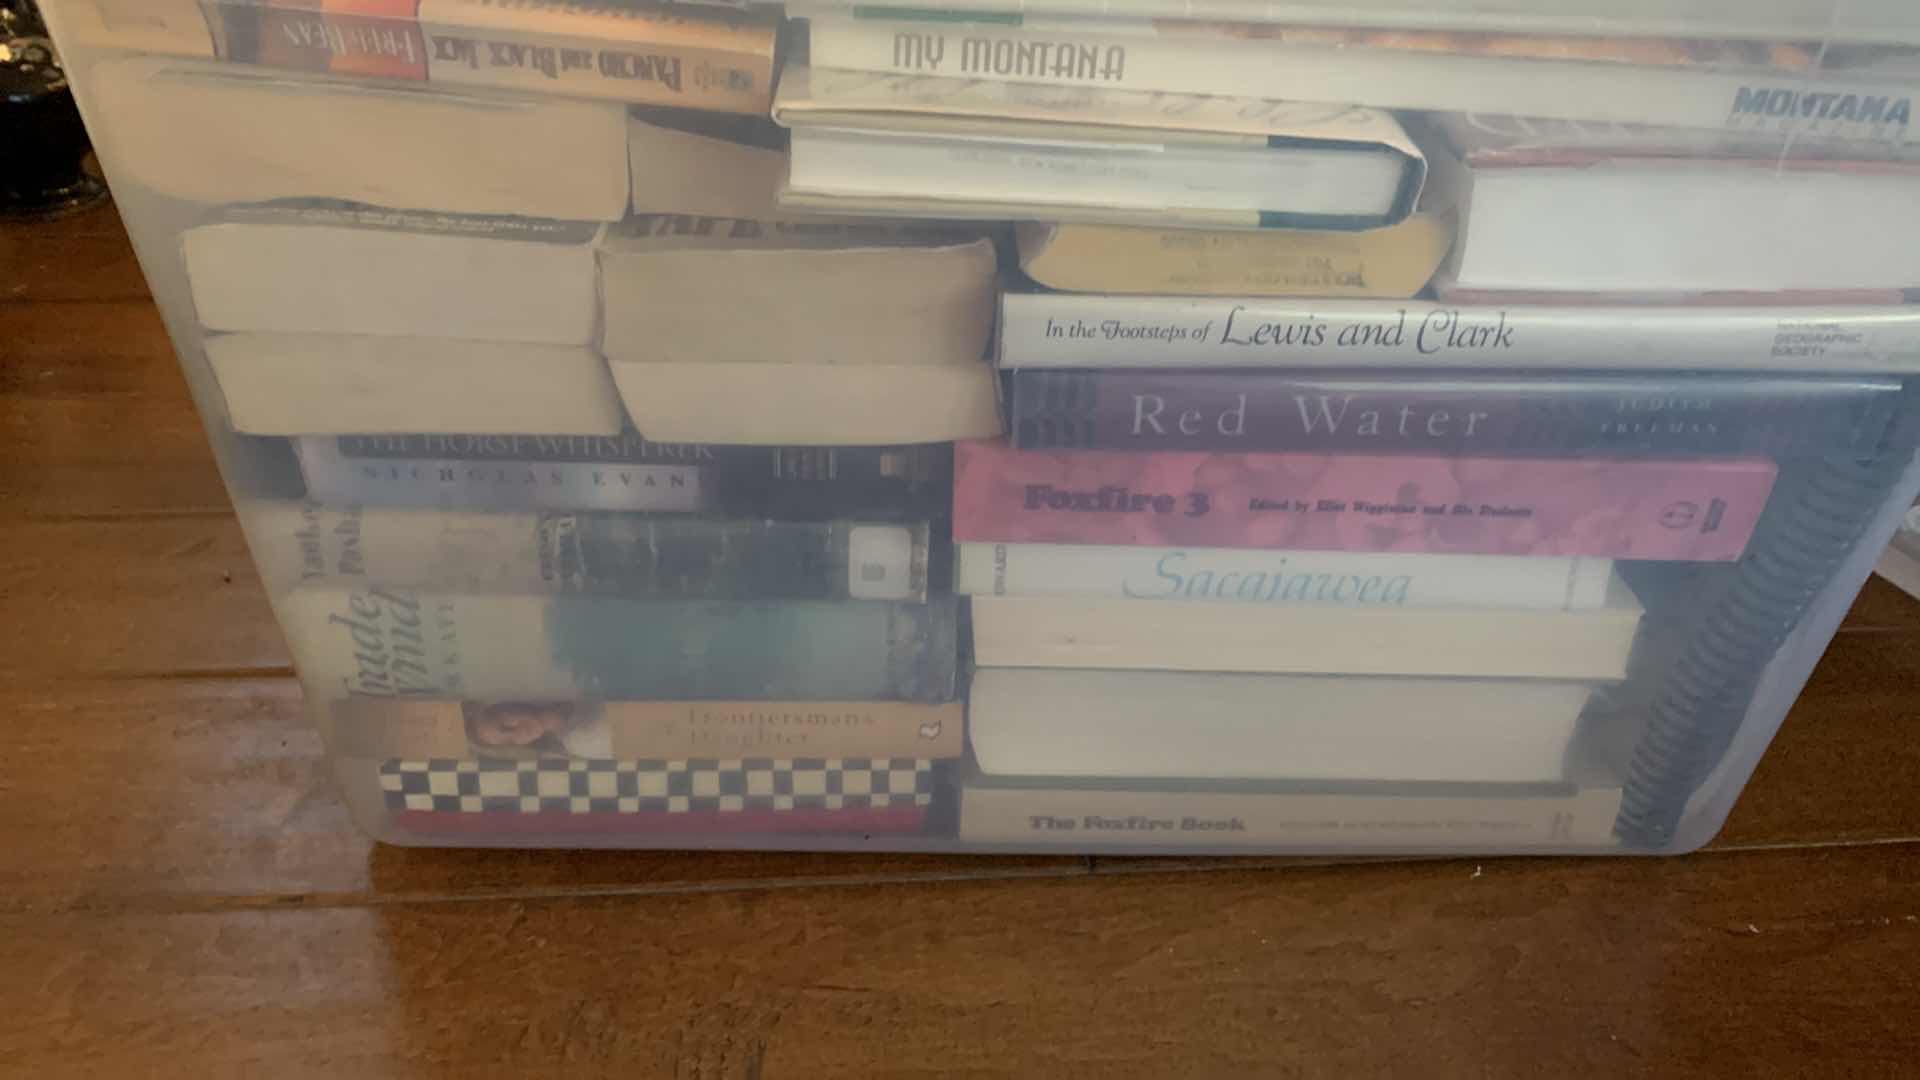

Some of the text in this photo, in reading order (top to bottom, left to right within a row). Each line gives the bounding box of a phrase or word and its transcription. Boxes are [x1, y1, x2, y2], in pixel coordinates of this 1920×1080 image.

[490, 40, 559, 80] BLACK
[892, 32, 1126, 81] MY MONTANA
[1733, 87, 1911, 127] MONTANA
[1045, 305, 1514, 354] In the Footsteps of Lewis and Clark
[1131, 395, 1489, 437] Red Water
[1023, 485, 1176, 514] Foxfire
[1184, 491, 1211, 518] 3
[1122, 550, 1413, 605] Sacajawea
[1028, 815, 1247, 833] The Foxfire Book
